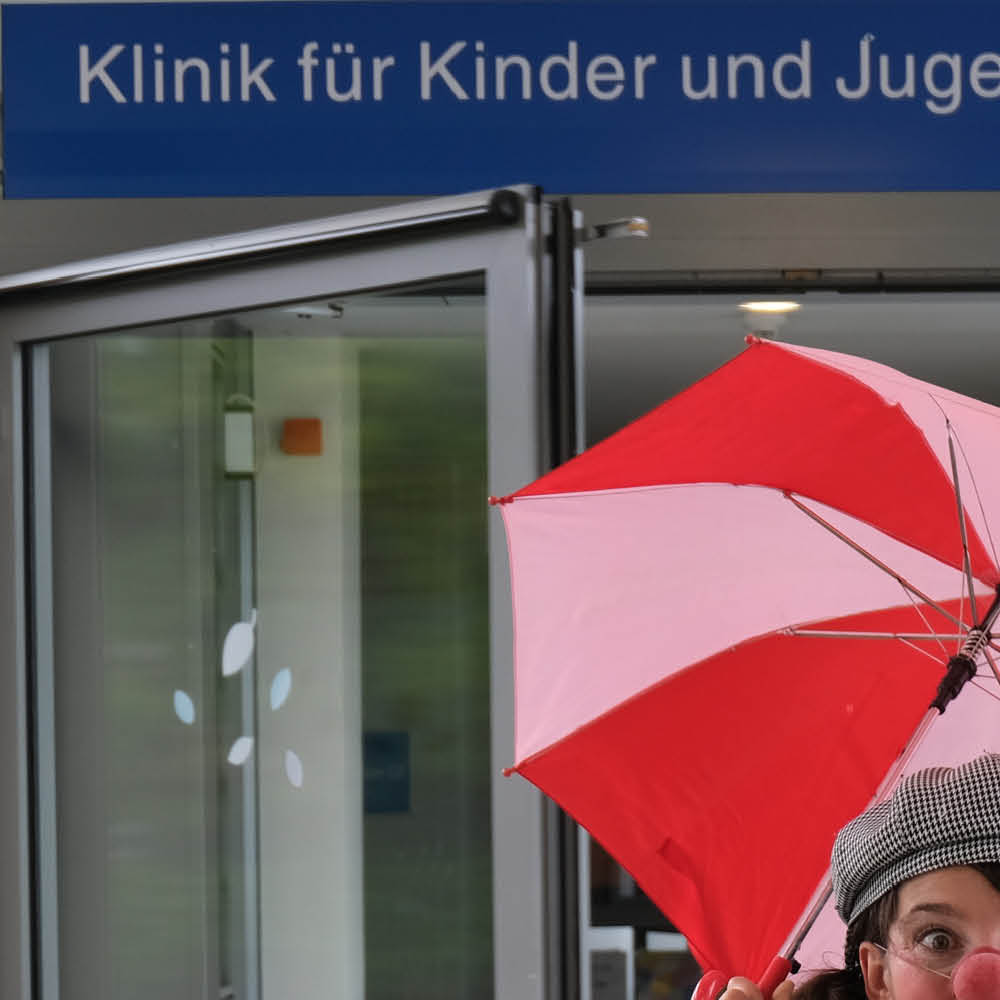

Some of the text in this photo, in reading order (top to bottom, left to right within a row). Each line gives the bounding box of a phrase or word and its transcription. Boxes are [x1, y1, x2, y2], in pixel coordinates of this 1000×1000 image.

[79, 43, 277, 104] Klinik
[297, 42, 395, 102] für
[420, 41, 657, 101] Kinder
[682, 40, 811, 100] und
